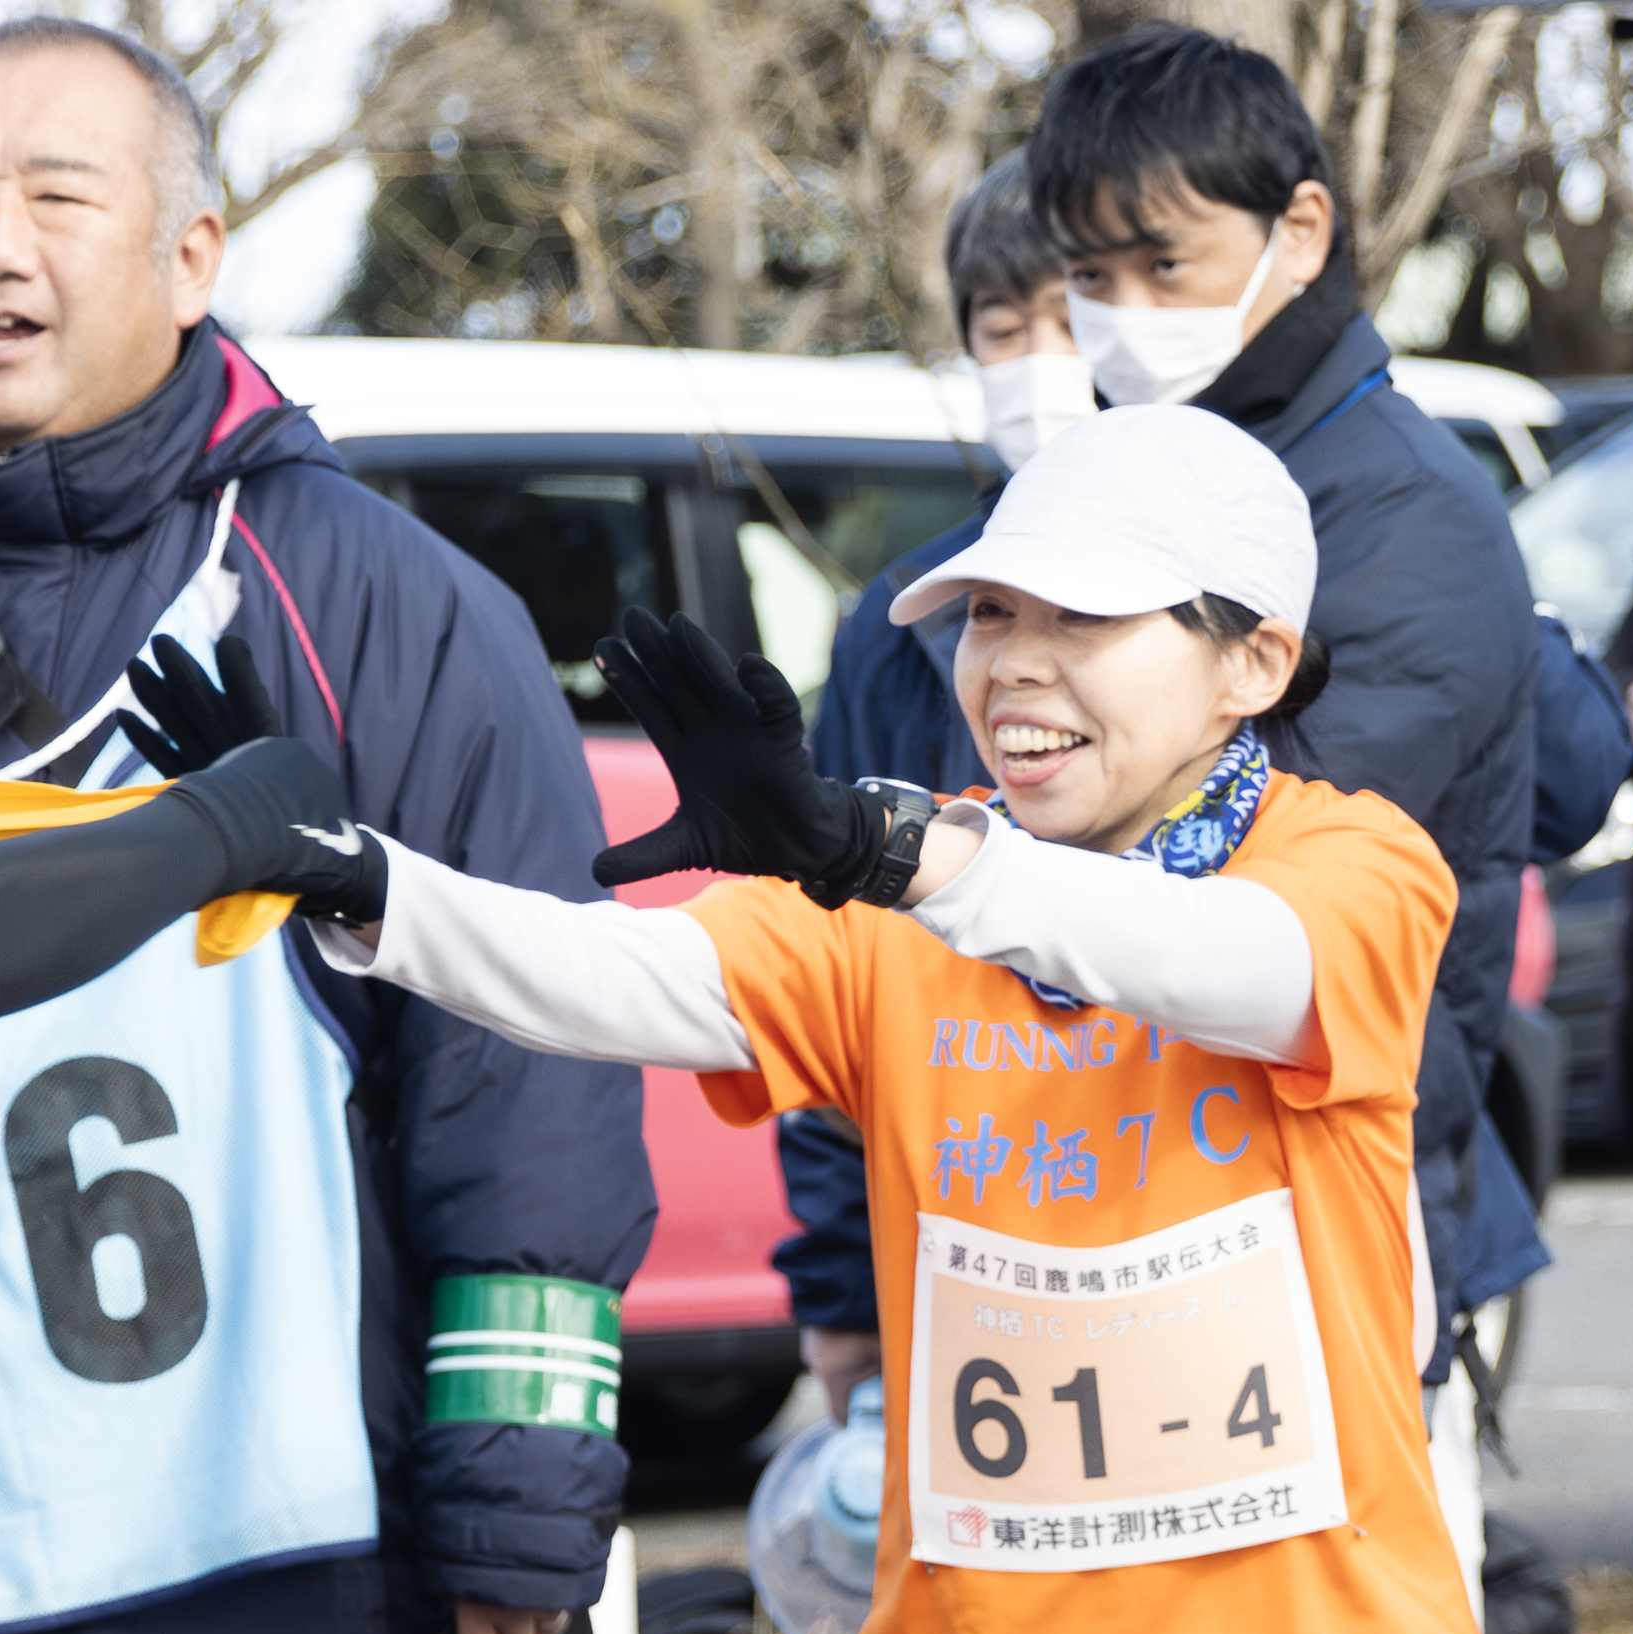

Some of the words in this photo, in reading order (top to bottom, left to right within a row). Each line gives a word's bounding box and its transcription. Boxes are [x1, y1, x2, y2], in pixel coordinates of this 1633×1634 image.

[927, 1017, 1118, 1072] RUNNIG
[3, 1055, 208, 1384] 6
[947, 1222, 1261, 1293] 第47回鹿嶋市駅伝大会
[954, 1357, 1106, 1479] 61
[1227, 1363, 1281, 1449] 4
[992, 1484, 1298, 1550] 東洋計測株式会社
